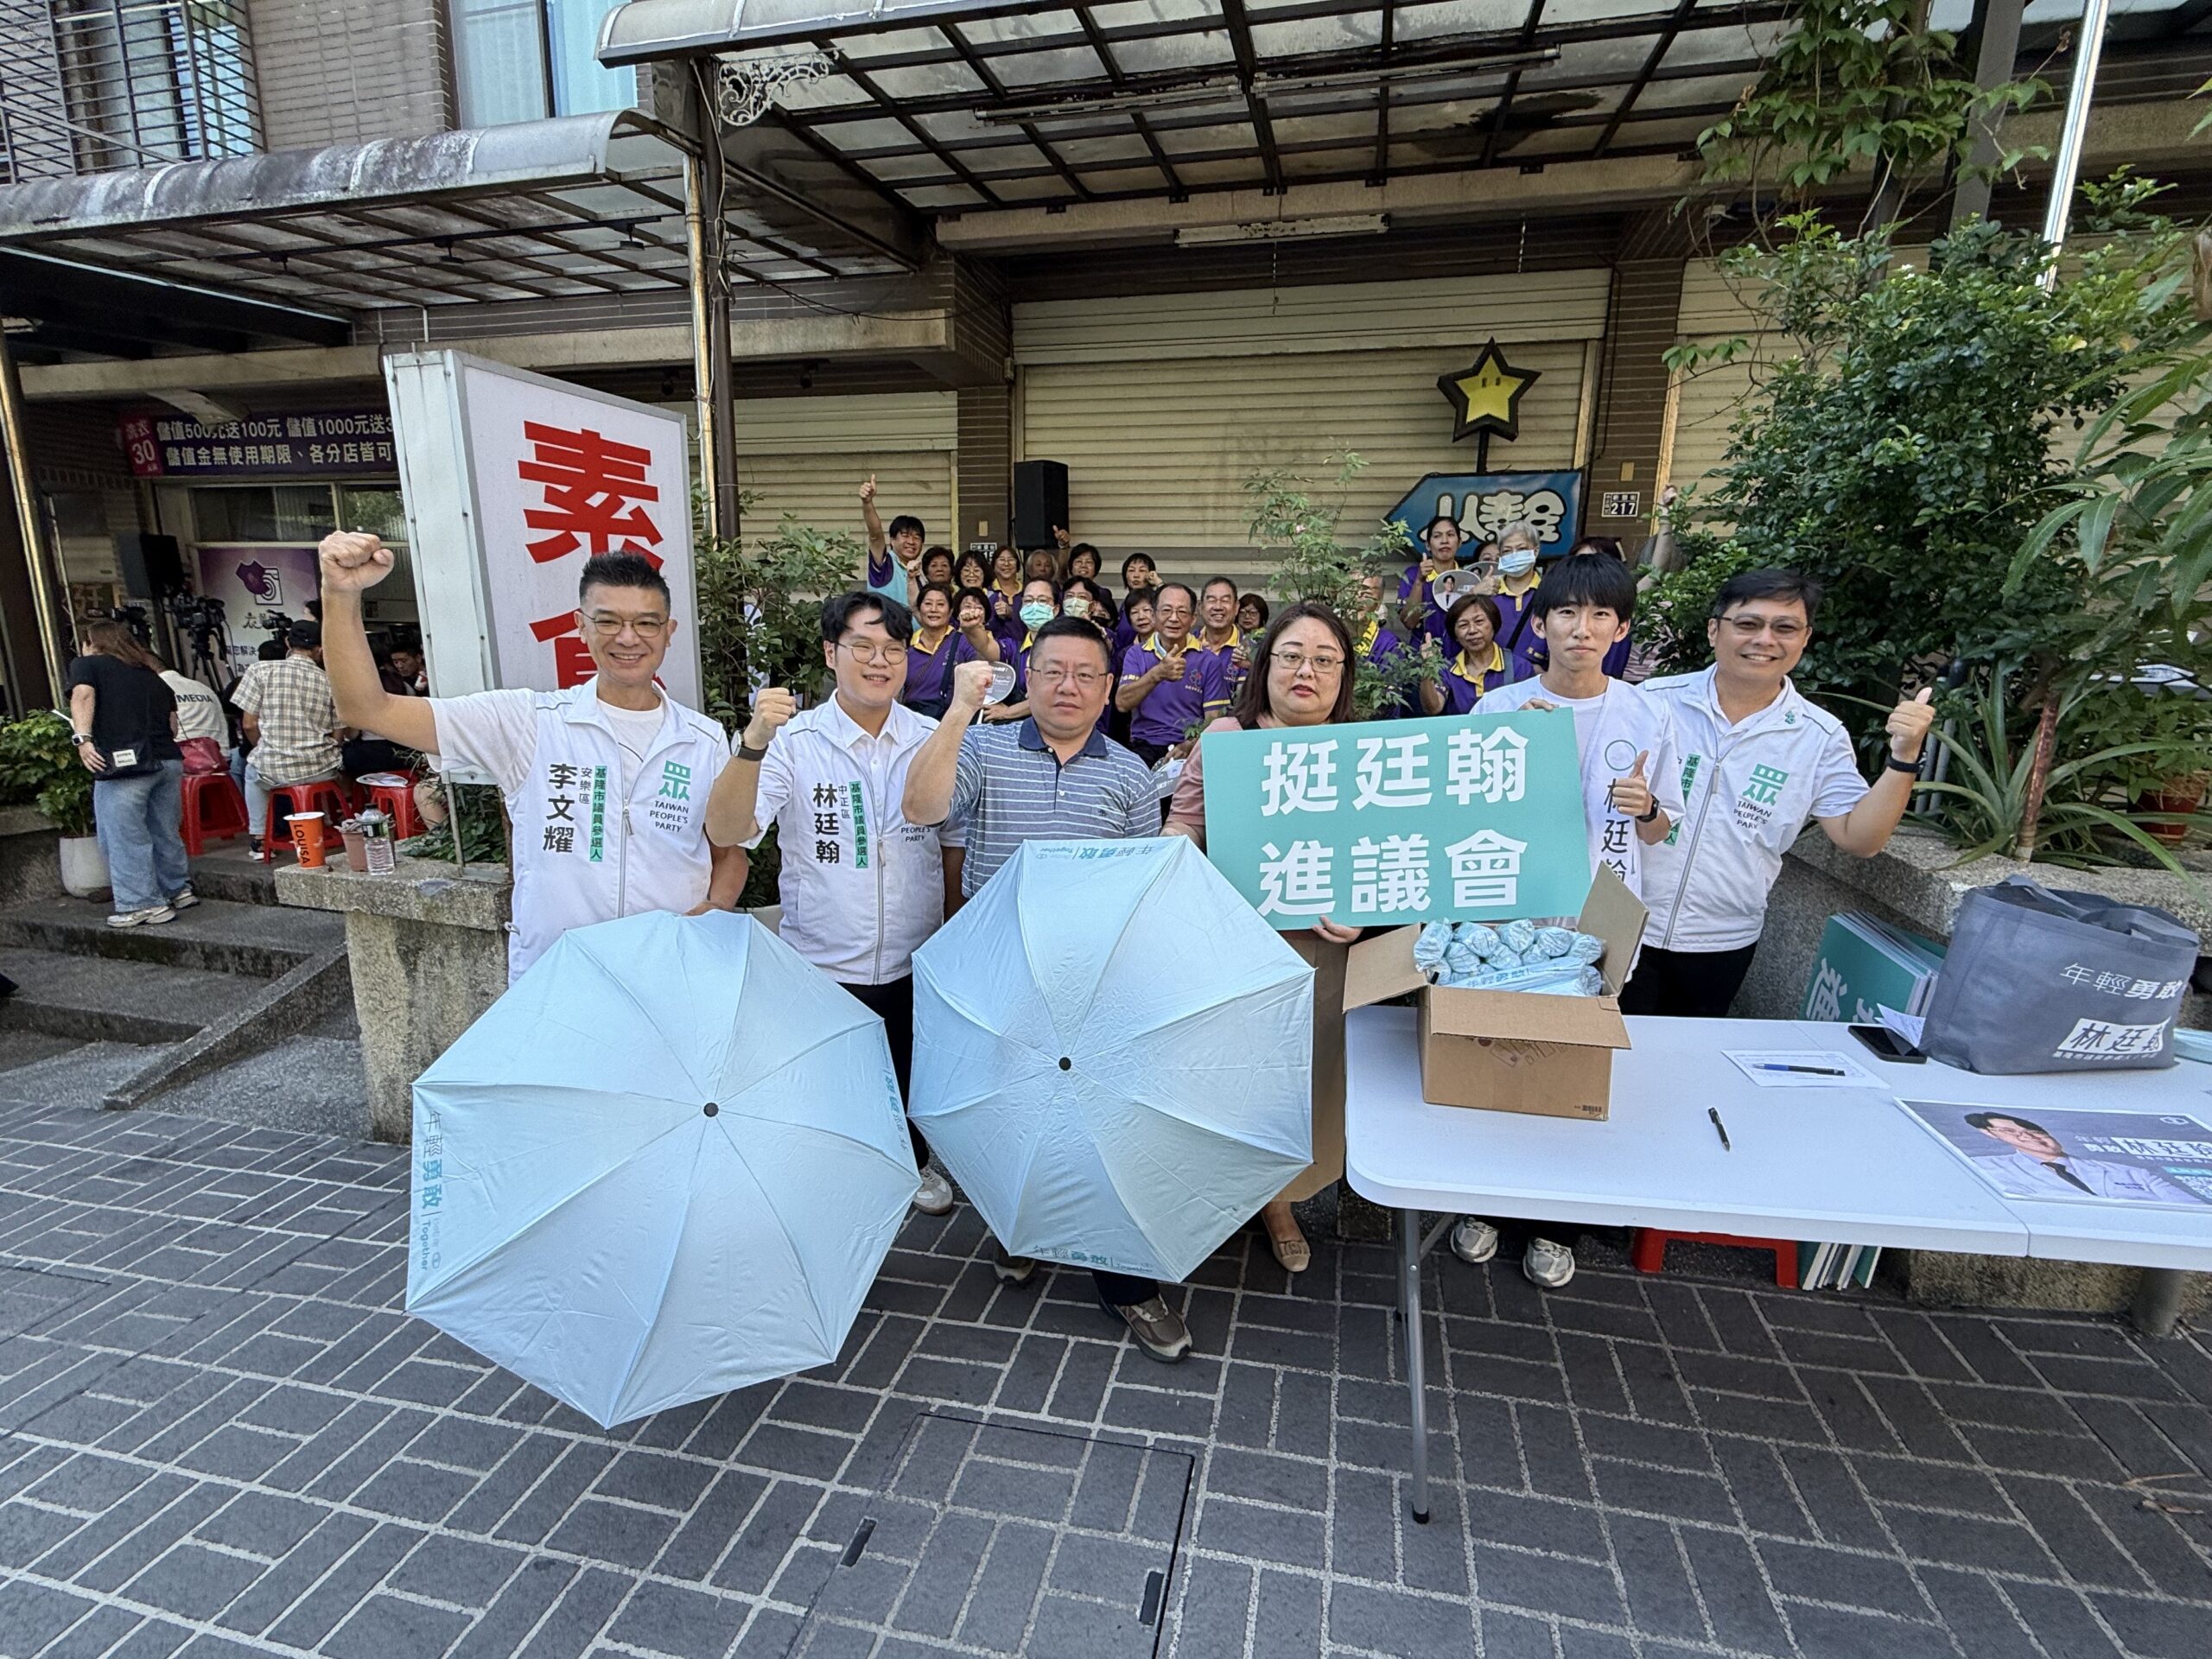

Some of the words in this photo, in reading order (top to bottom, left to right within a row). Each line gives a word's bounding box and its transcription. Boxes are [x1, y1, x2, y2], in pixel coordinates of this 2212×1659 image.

[131, 439, 156, 465] 30
[166, 442, 392, 467] 儲值金無使用期限、各分店皆可
[1611, 502, 1636, 515] 217
[176, 694, 213, 704] MEDIA
[579, 766, 593, 805] 安樂區
[658, 760, 691, 802] 眾
[1260, 726, 1529, 817] 挺廷翰
[1742, 764, 1789, 806] 眾
[543, 763, 578, 854] 李文耀
[649, 810, 689, 824] PEOPLE'S
[654, 800, 690, 814] TAIWAN
[838, 785, 851, 819] 中正區
[1738, 800, 1772, 817] TAIWAN
[654, 821, 683, 833] PARTY
[813, 782, 841, 864] 林廷翰
[294, 824, 311, 864] LOUISA
[1256, 829, 1529, 918] 進議會
[2060, 963, 2184, 1000] 年輕勇敢
[421, 1110, 443, 1210] 年輕勇敢
[420, 1220, 431, 1271] Together
